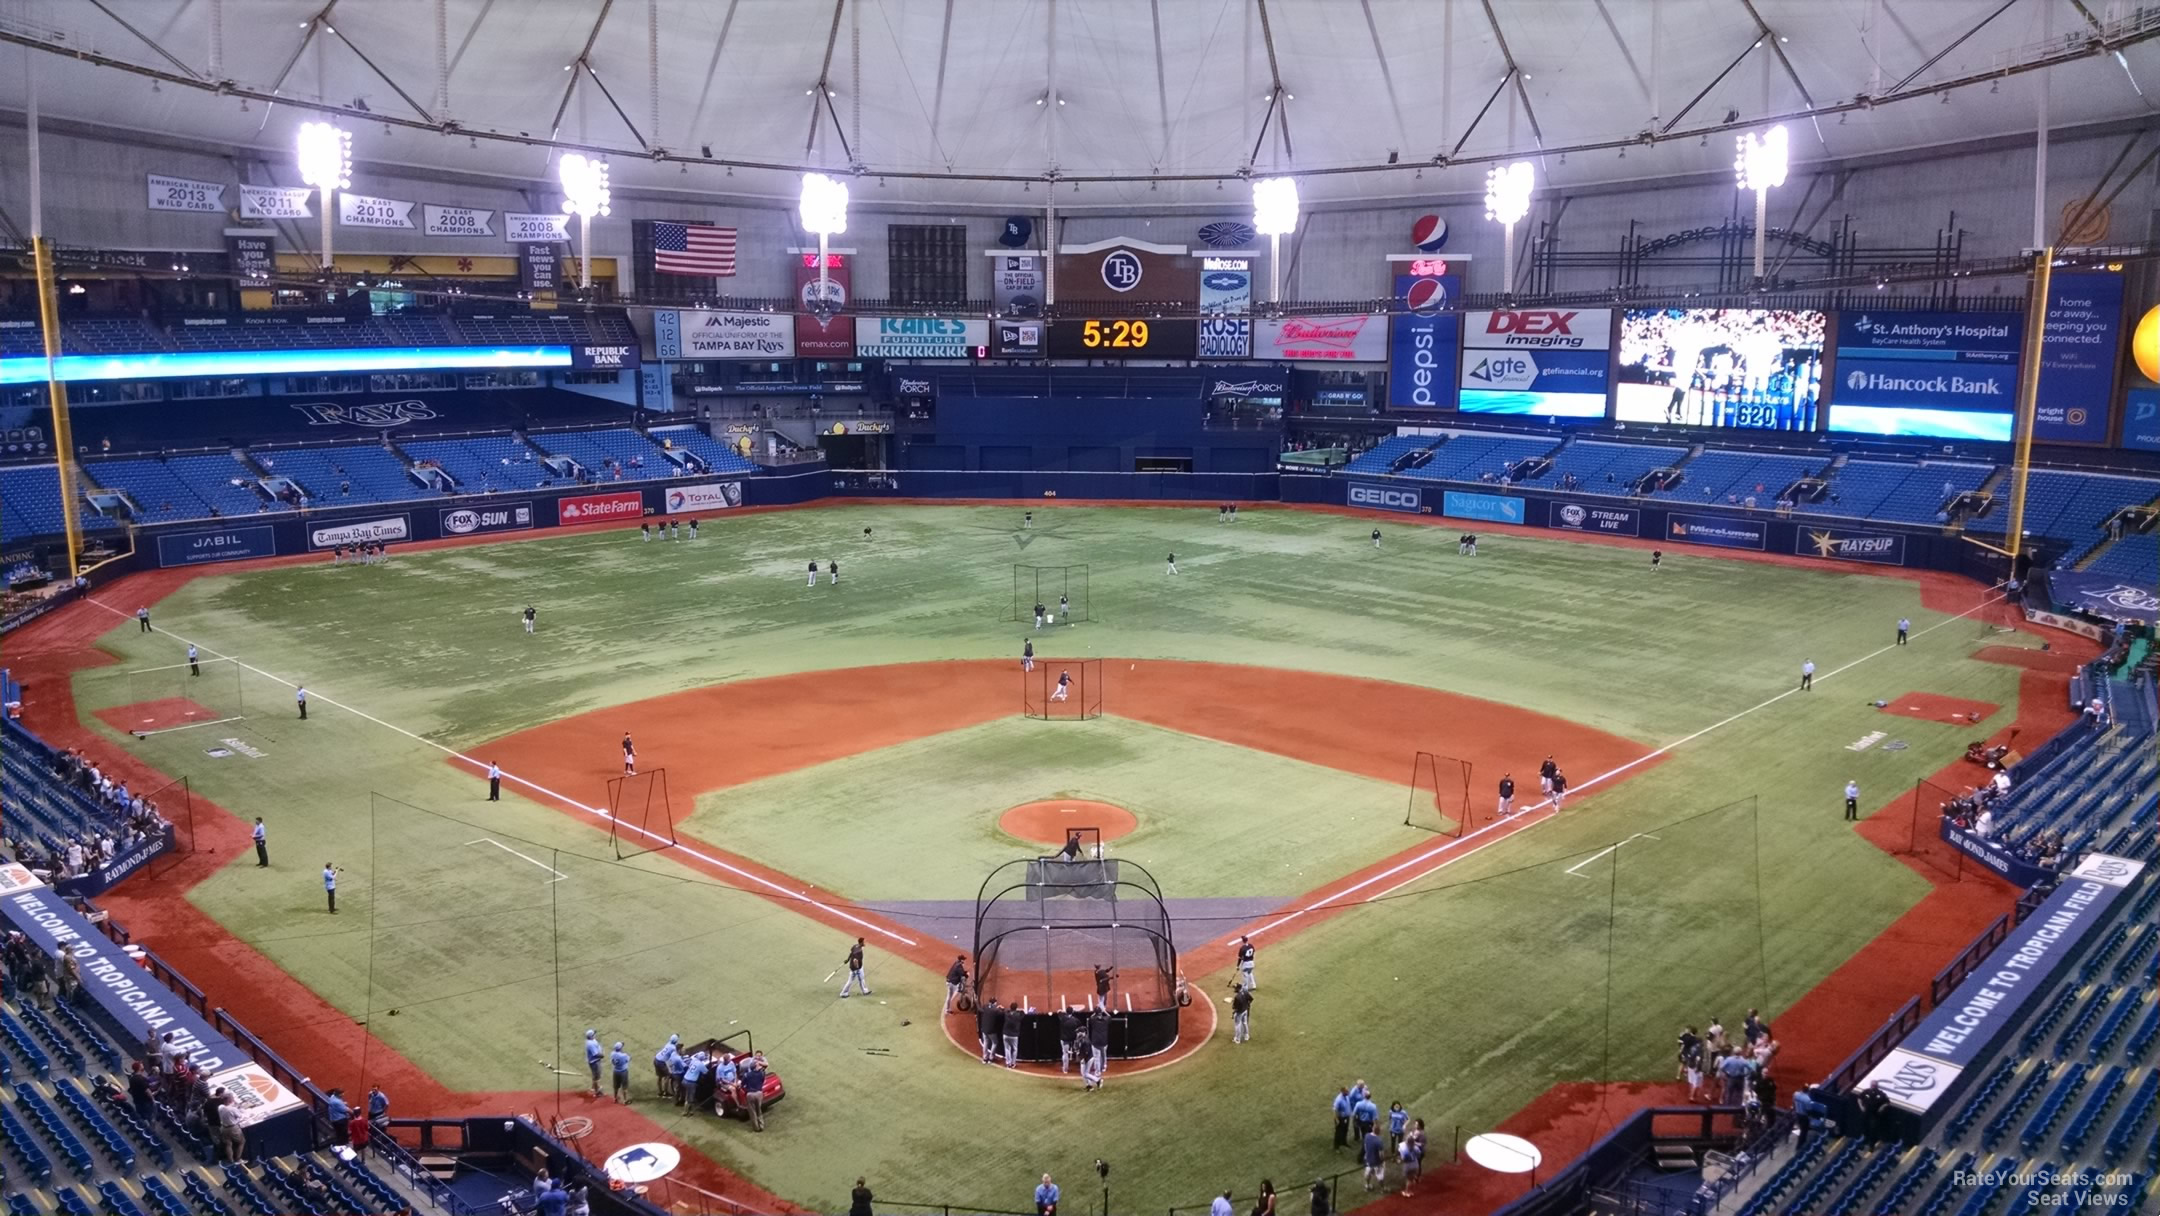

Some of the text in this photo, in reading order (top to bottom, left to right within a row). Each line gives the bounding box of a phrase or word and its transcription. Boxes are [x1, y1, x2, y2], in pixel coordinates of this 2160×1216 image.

[151, 179, 221, 192] AMERICAN LEAGUE
[168, 187, 206, 201] 2013
[157, 198, 215, 210] WILD CARD
[259, 197, 293, 208] 2011
[360, 198, 370, 206] AL
[248, 207, 302, 216] WILD CARD
[357, 204, 395, 218] 2010
[346, 215, 404, 227] CHAMPIONS
[440, 215, 476, 227] 2008
[520, 222, 554, 232] 2008
[430, 225, 485, 235] CHAMPIONS
[511, 232, 563, 240] CHAMPIONS
[238, 240, 266, 250] Have
[529, 246, 550, 254] Fast
[243, 250, 264, 260] you
[529, 255, 554, 264] news
[533, 264, 552, 272] you
[1109, 258, 1136, 284] TB
[534, 272, 552, 280] can
[533, 280, 552, 288] use.
[2060, 297, 2092, 307] home
[660, 313, 675, 324] 42
[2064, 311, 2100, 320] away...
[724, 316, 770, 329] Majestic
[1200, 318, 1249, 336] ROSE
[1486, 311, 1580, 335] DEX
[2086, 323, 2108, 333] you
[662, 329, 674, 340] 12
[1083, 320, 1149, 348] 5:29
[1872, 324, 2009, 340] St. Anthony's Hospital
[884, 336, 961, 344] FURNITURE
[1505, 334, 1584, 348] imaging
[1922, 338, 1946, 346] System
[2042, 334, 2102, 344] connected.
[584, 346, 630, 356] REPUBLIC
[661, 344, 676, 356] 66
[692, 339, 784, 354] TAMPA BAY RAYS
[1200, 336, 1249, 356] RADIOLOGY
[594, 356, 622, 364] BANK
[1412, 328, 1438, 406] pepsi
[1492, 357, 1526, 378] gte
[1542, 368, 1604, 378] gtefinancial.org
[900, 385, 930, 393] PORCH
[1253, 384, 1283, 392] PORCH
[1869, 374, 1948, 392] Hancock
[1951, 376, 2000, 394] Bank
[290, 400, 437, 427] RAYS
[1738, 404, 1776, 426] 620
[2038, 407, 2064, 416] bright
[688, 493, 722, 502] TOTAL
[1350, 487, 1418, 508] GEICO
[1451, 494, 1497, 512] Sagicor
[1566, 508, 1580, 516] FOX
[1592, 510, 1629, 522] STREAM
[452, 514, 472, 524] FOX
[481, 512, 508, 526] SUN
[1600, 520, 1620, 529] LIVE
[318, 524, 402, 544] Tampa Bay Times
[1690, 525, 1760, 538] MicroLumen
[194, 534, 242, 548] JABIL
[104, 852, 142, 884] RAYMOND
[1984, 852, 2009, 873] JAMES
[2082, 859, 2130, 881] RAYS
[1923, 882, 2104, 1055] WELCOME TO TROPICANA FIELD
[12, 892, 224, 1072] WELCOME TO TROPICANA FIELD
[1876, 1060, 1936, 1100] RAYS
